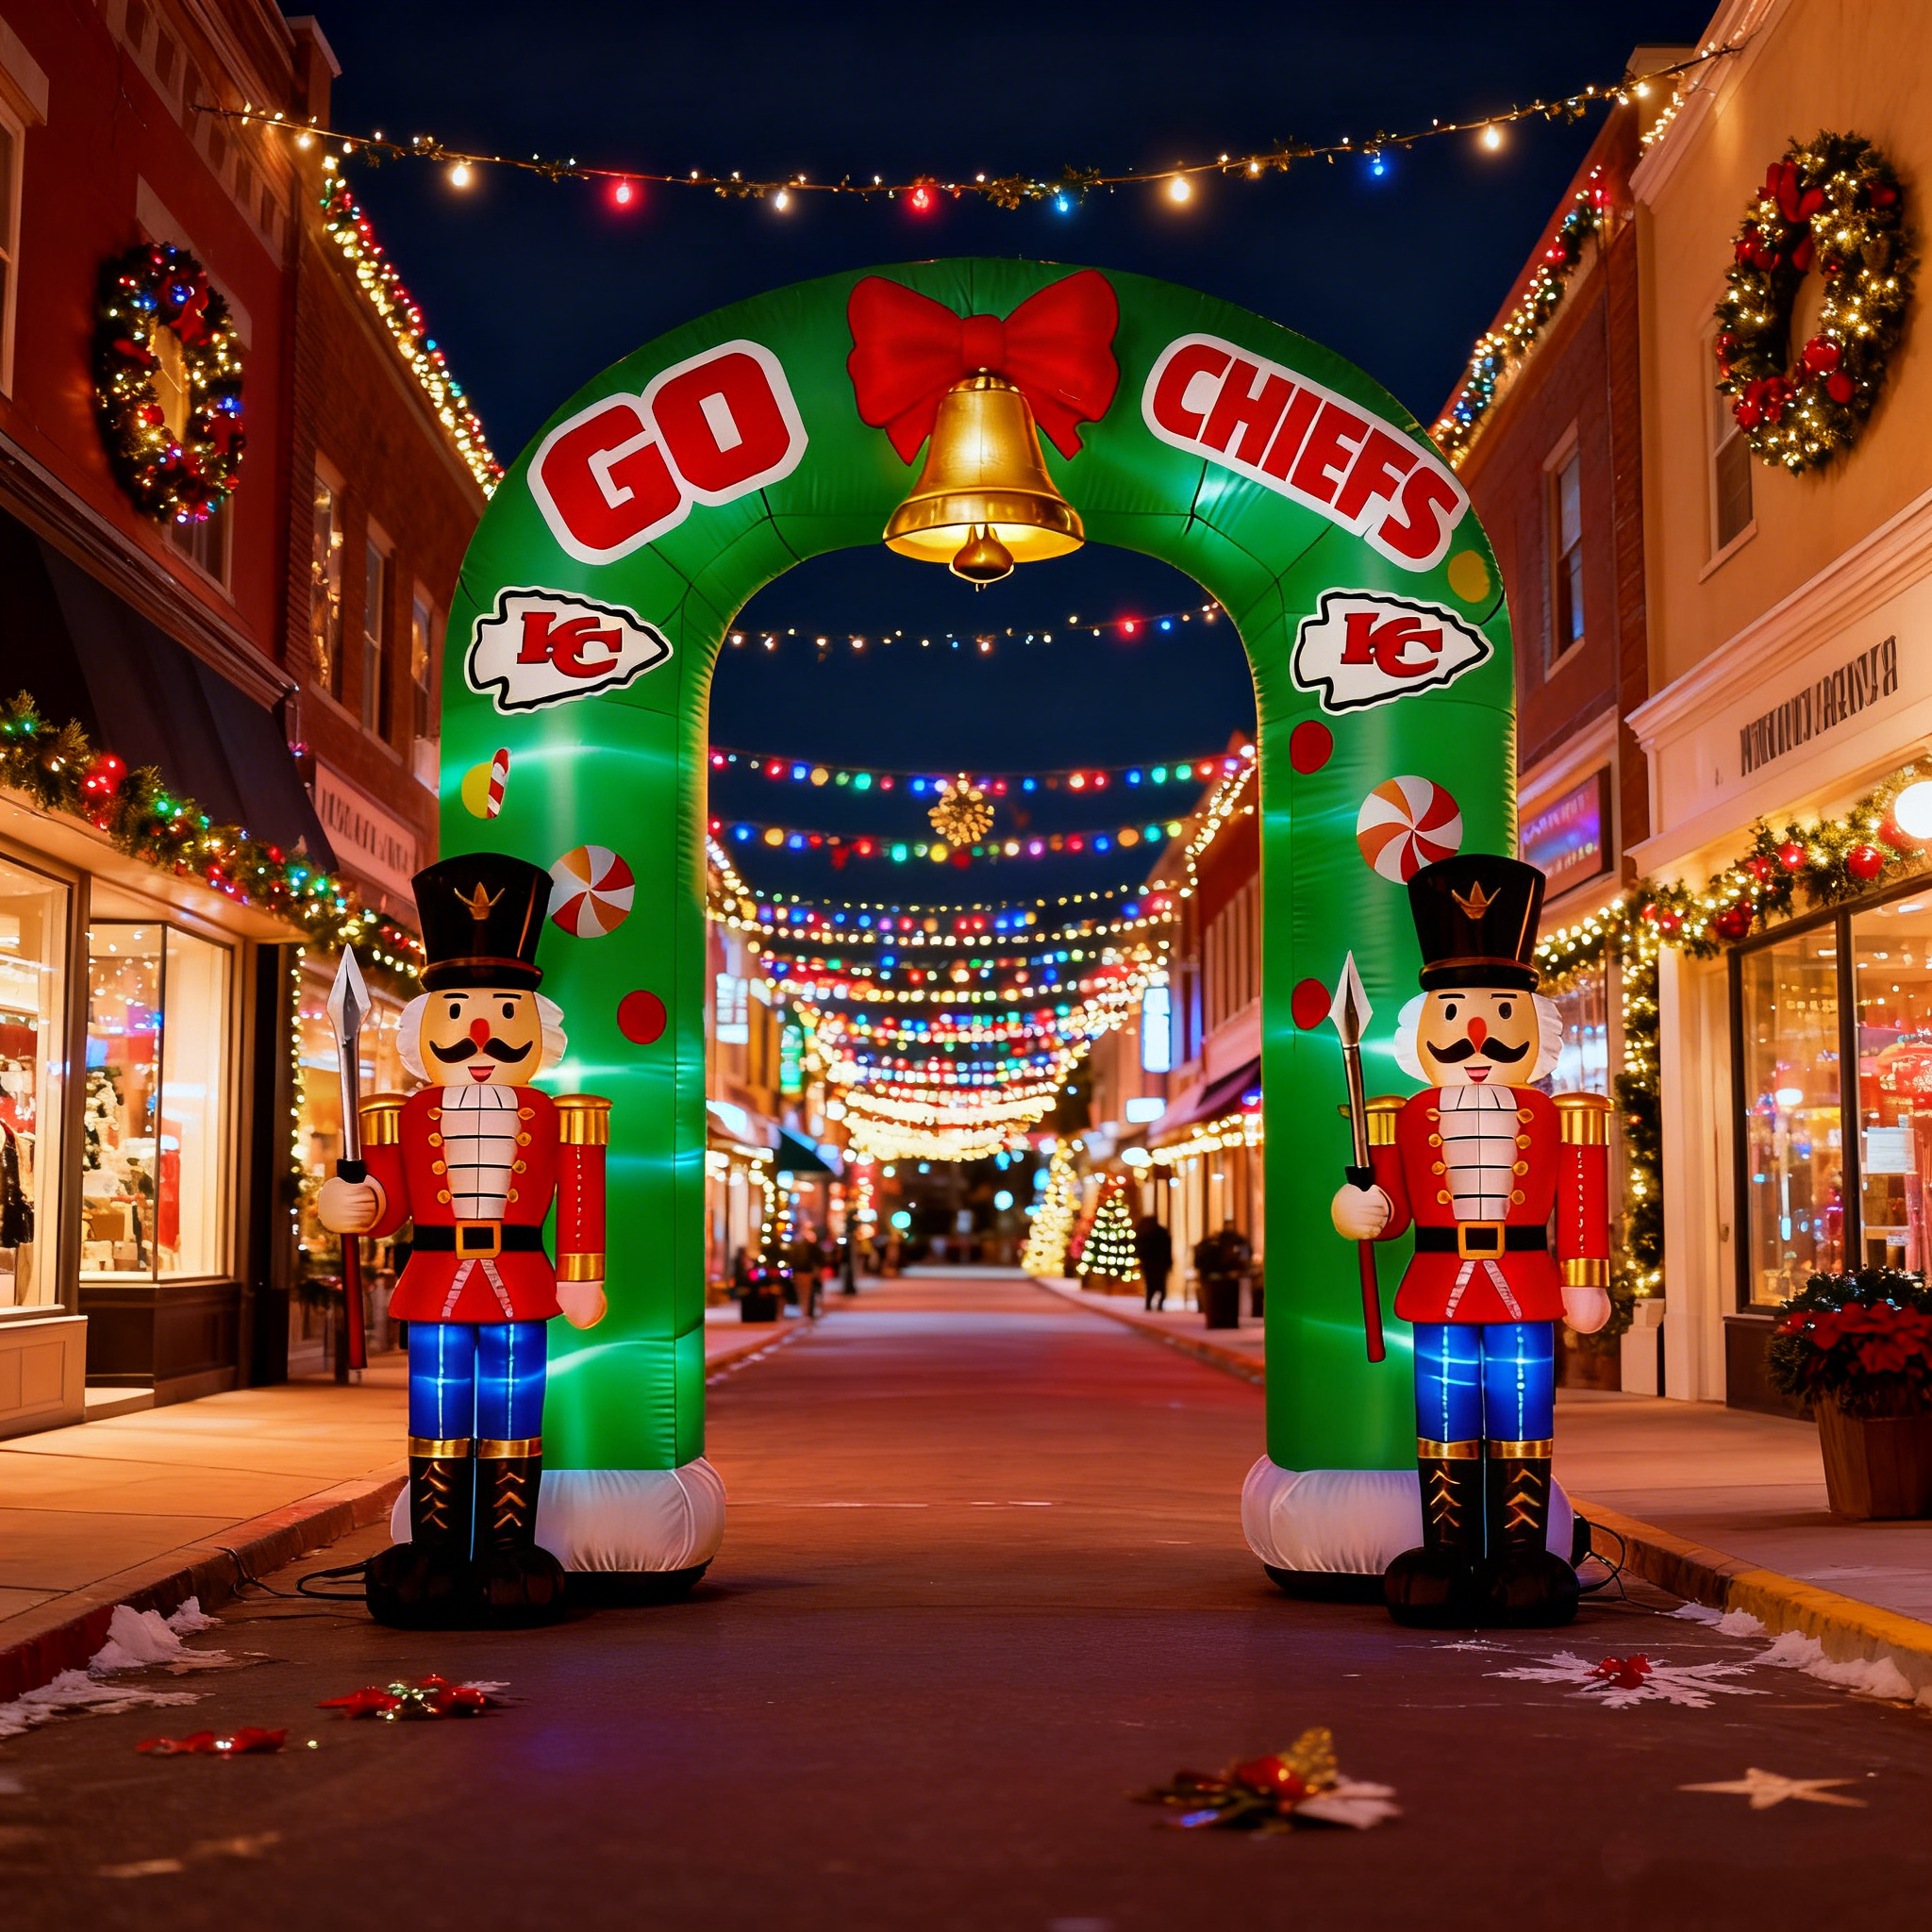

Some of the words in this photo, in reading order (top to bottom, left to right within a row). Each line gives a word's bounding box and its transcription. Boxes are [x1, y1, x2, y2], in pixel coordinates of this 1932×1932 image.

[541, 352, 791, 550] GO
[1153, 343, 1459, 559] CHIEFS
[516, 611, 622, 678] KC
[1340, 612, 1443, 678] KC
